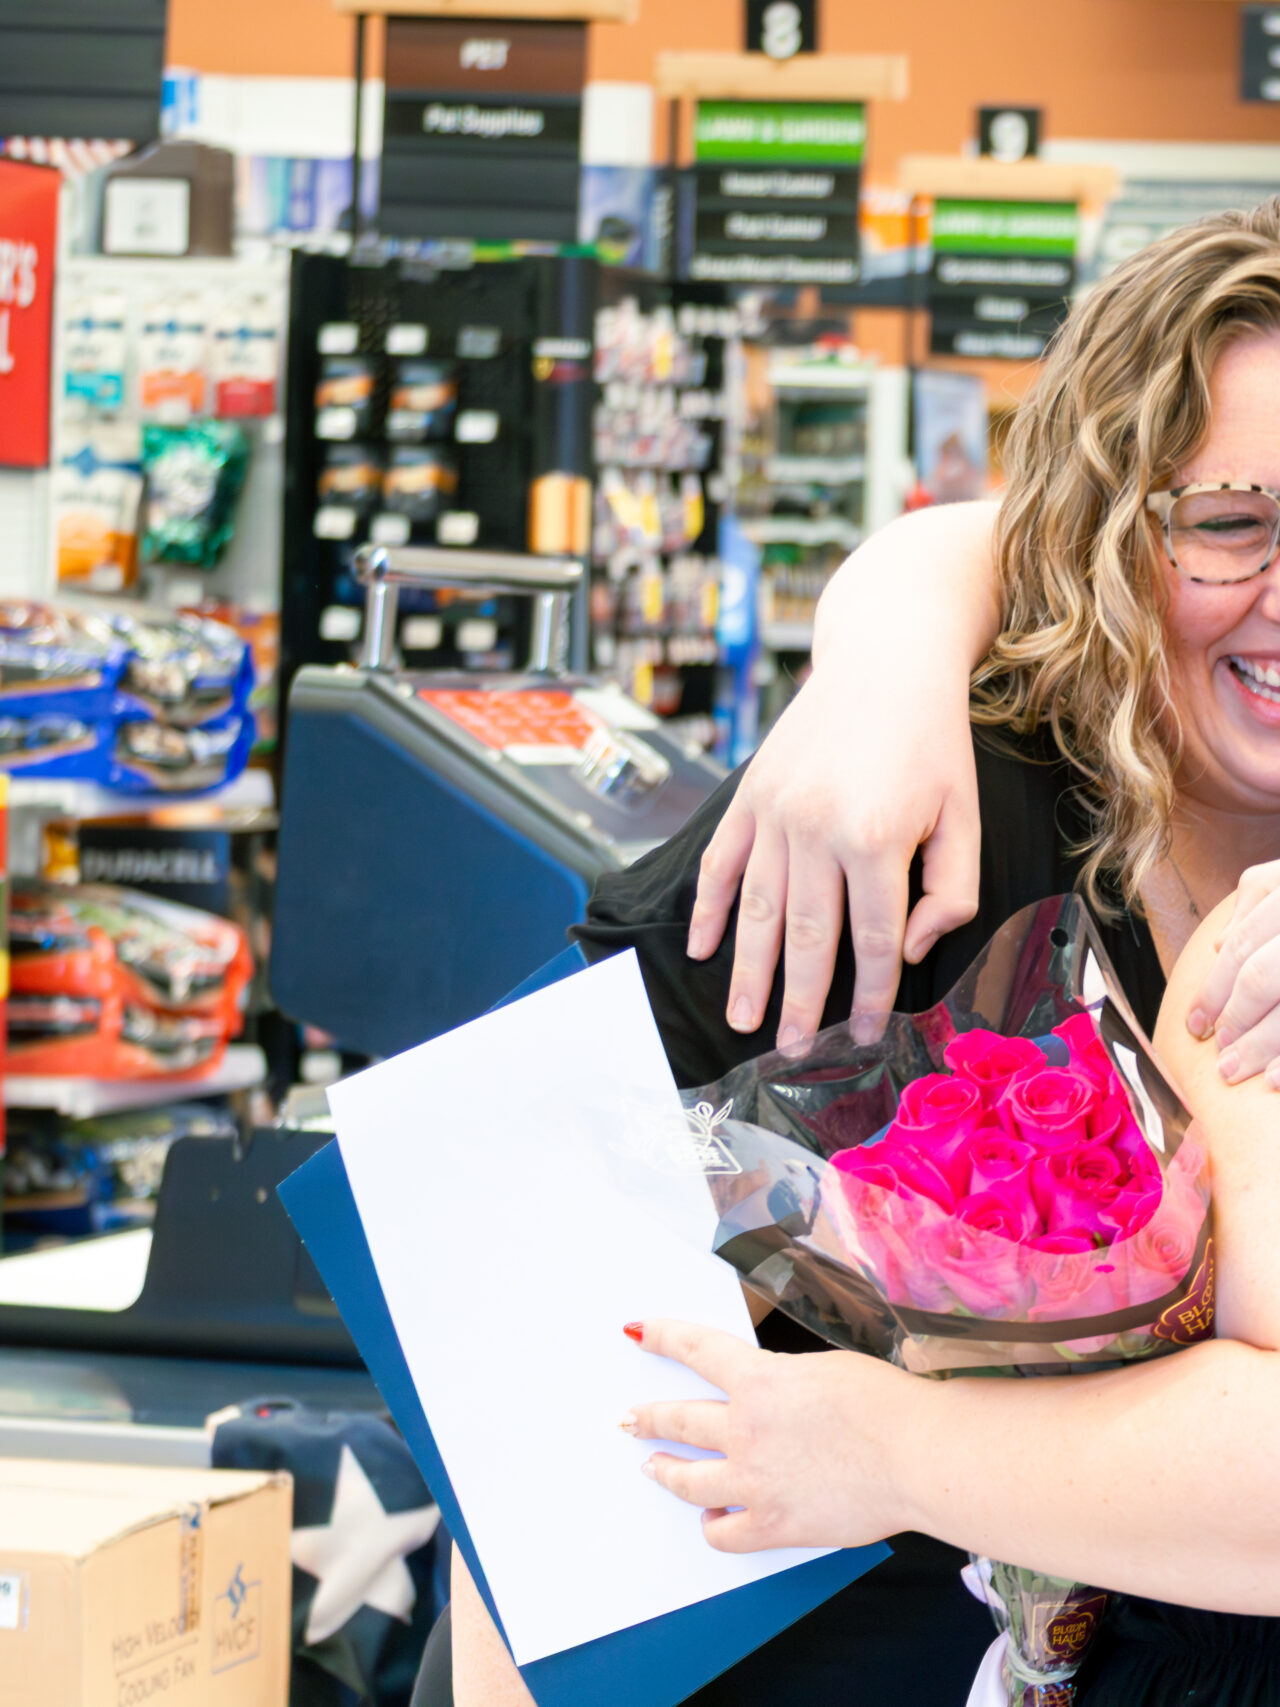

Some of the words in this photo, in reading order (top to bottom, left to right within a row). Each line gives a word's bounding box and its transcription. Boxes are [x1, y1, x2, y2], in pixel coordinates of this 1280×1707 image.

[762, 1, 801, 59] 8
[460, 38, 510, 70] PET
[423, 104, 461, 133] Pet
[462, 105, 544, 138] Supplies
[990, 112, 1028, 163] 9
[82, 849, 218, 885] DURACELL
[1052, 1632, 1086, 1646] HAUS
[1053, 1621, 1087, 1635] BLOOM
[112, 1634, 142, 1659] HIGH
[118, 1667, 170, 1707] COOLING
[174, 1656, 196, 1684] FAN
